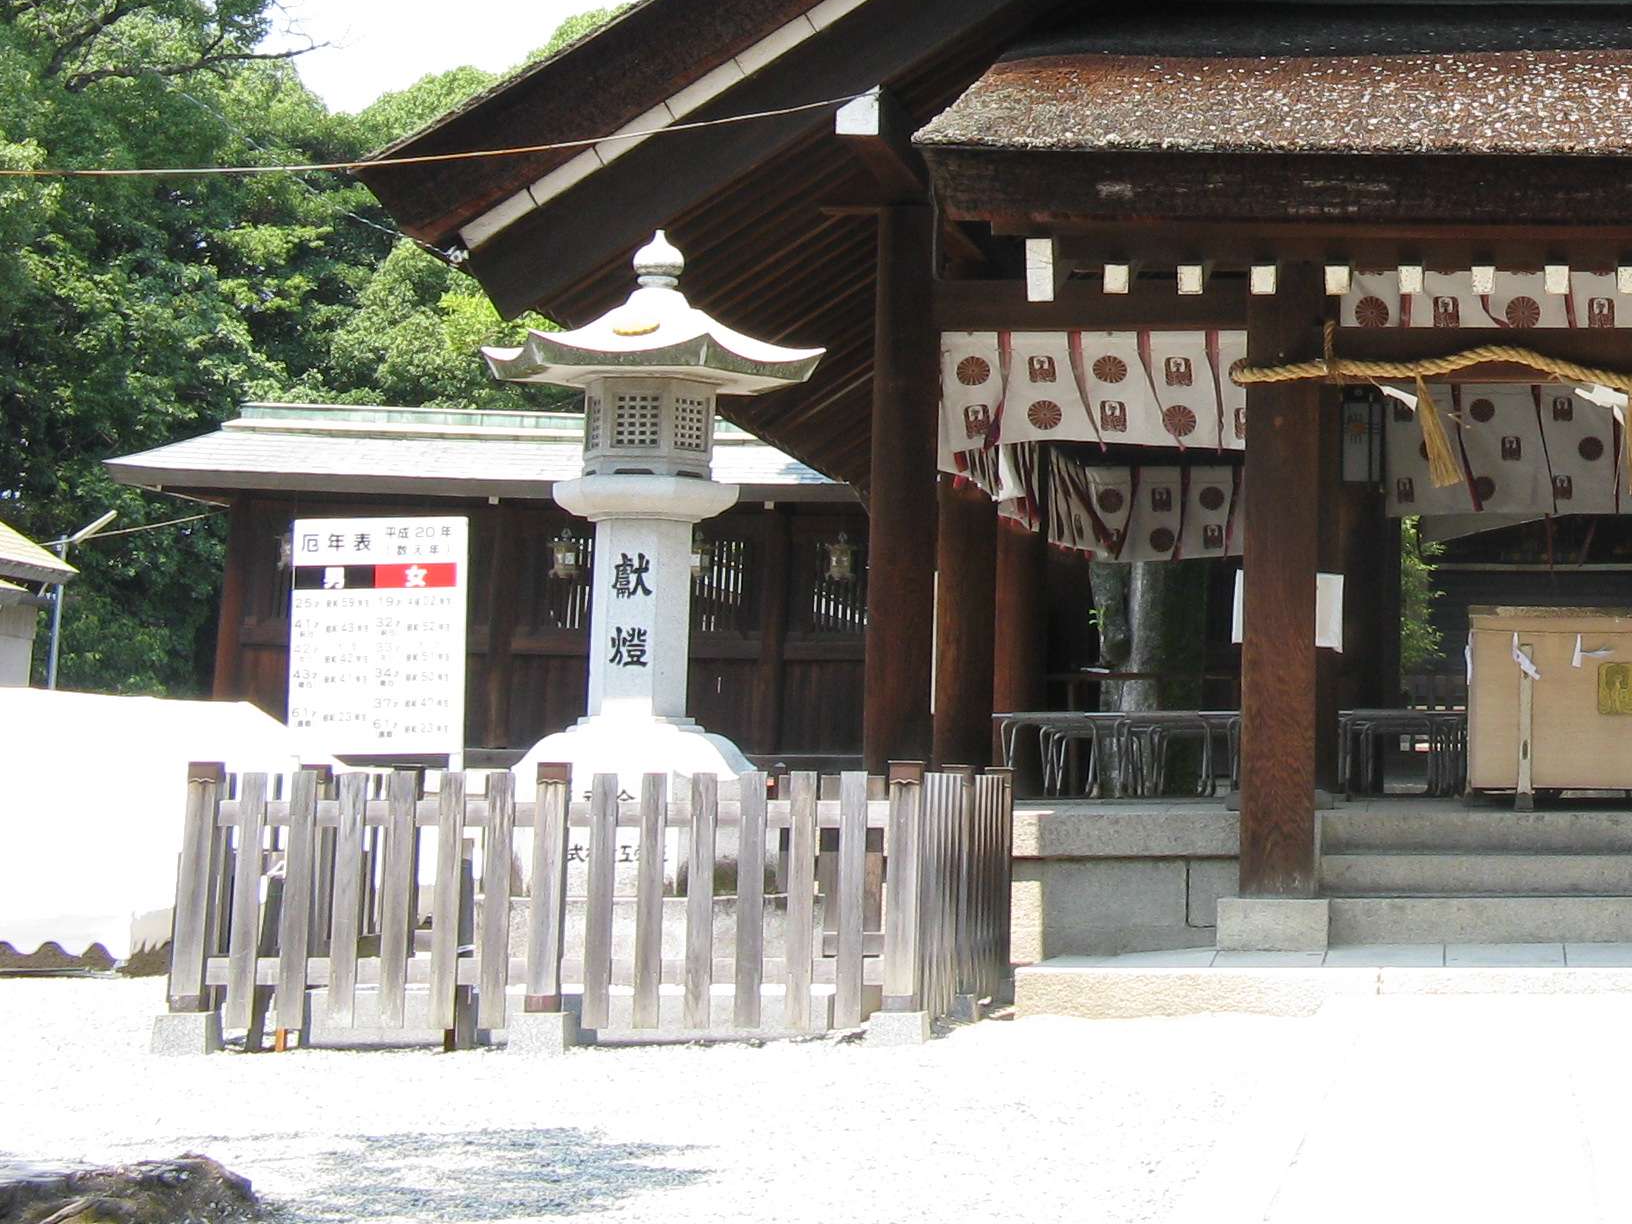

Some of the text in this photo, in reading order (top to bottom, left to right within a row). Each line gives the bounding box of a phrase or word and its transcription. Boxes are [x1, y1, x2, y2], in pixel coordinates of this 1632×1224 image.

[385, 526, 453, 539] 平成20年
[301, 533, 371, 552] 厄年表
[404, 564, 428, 588] 女
